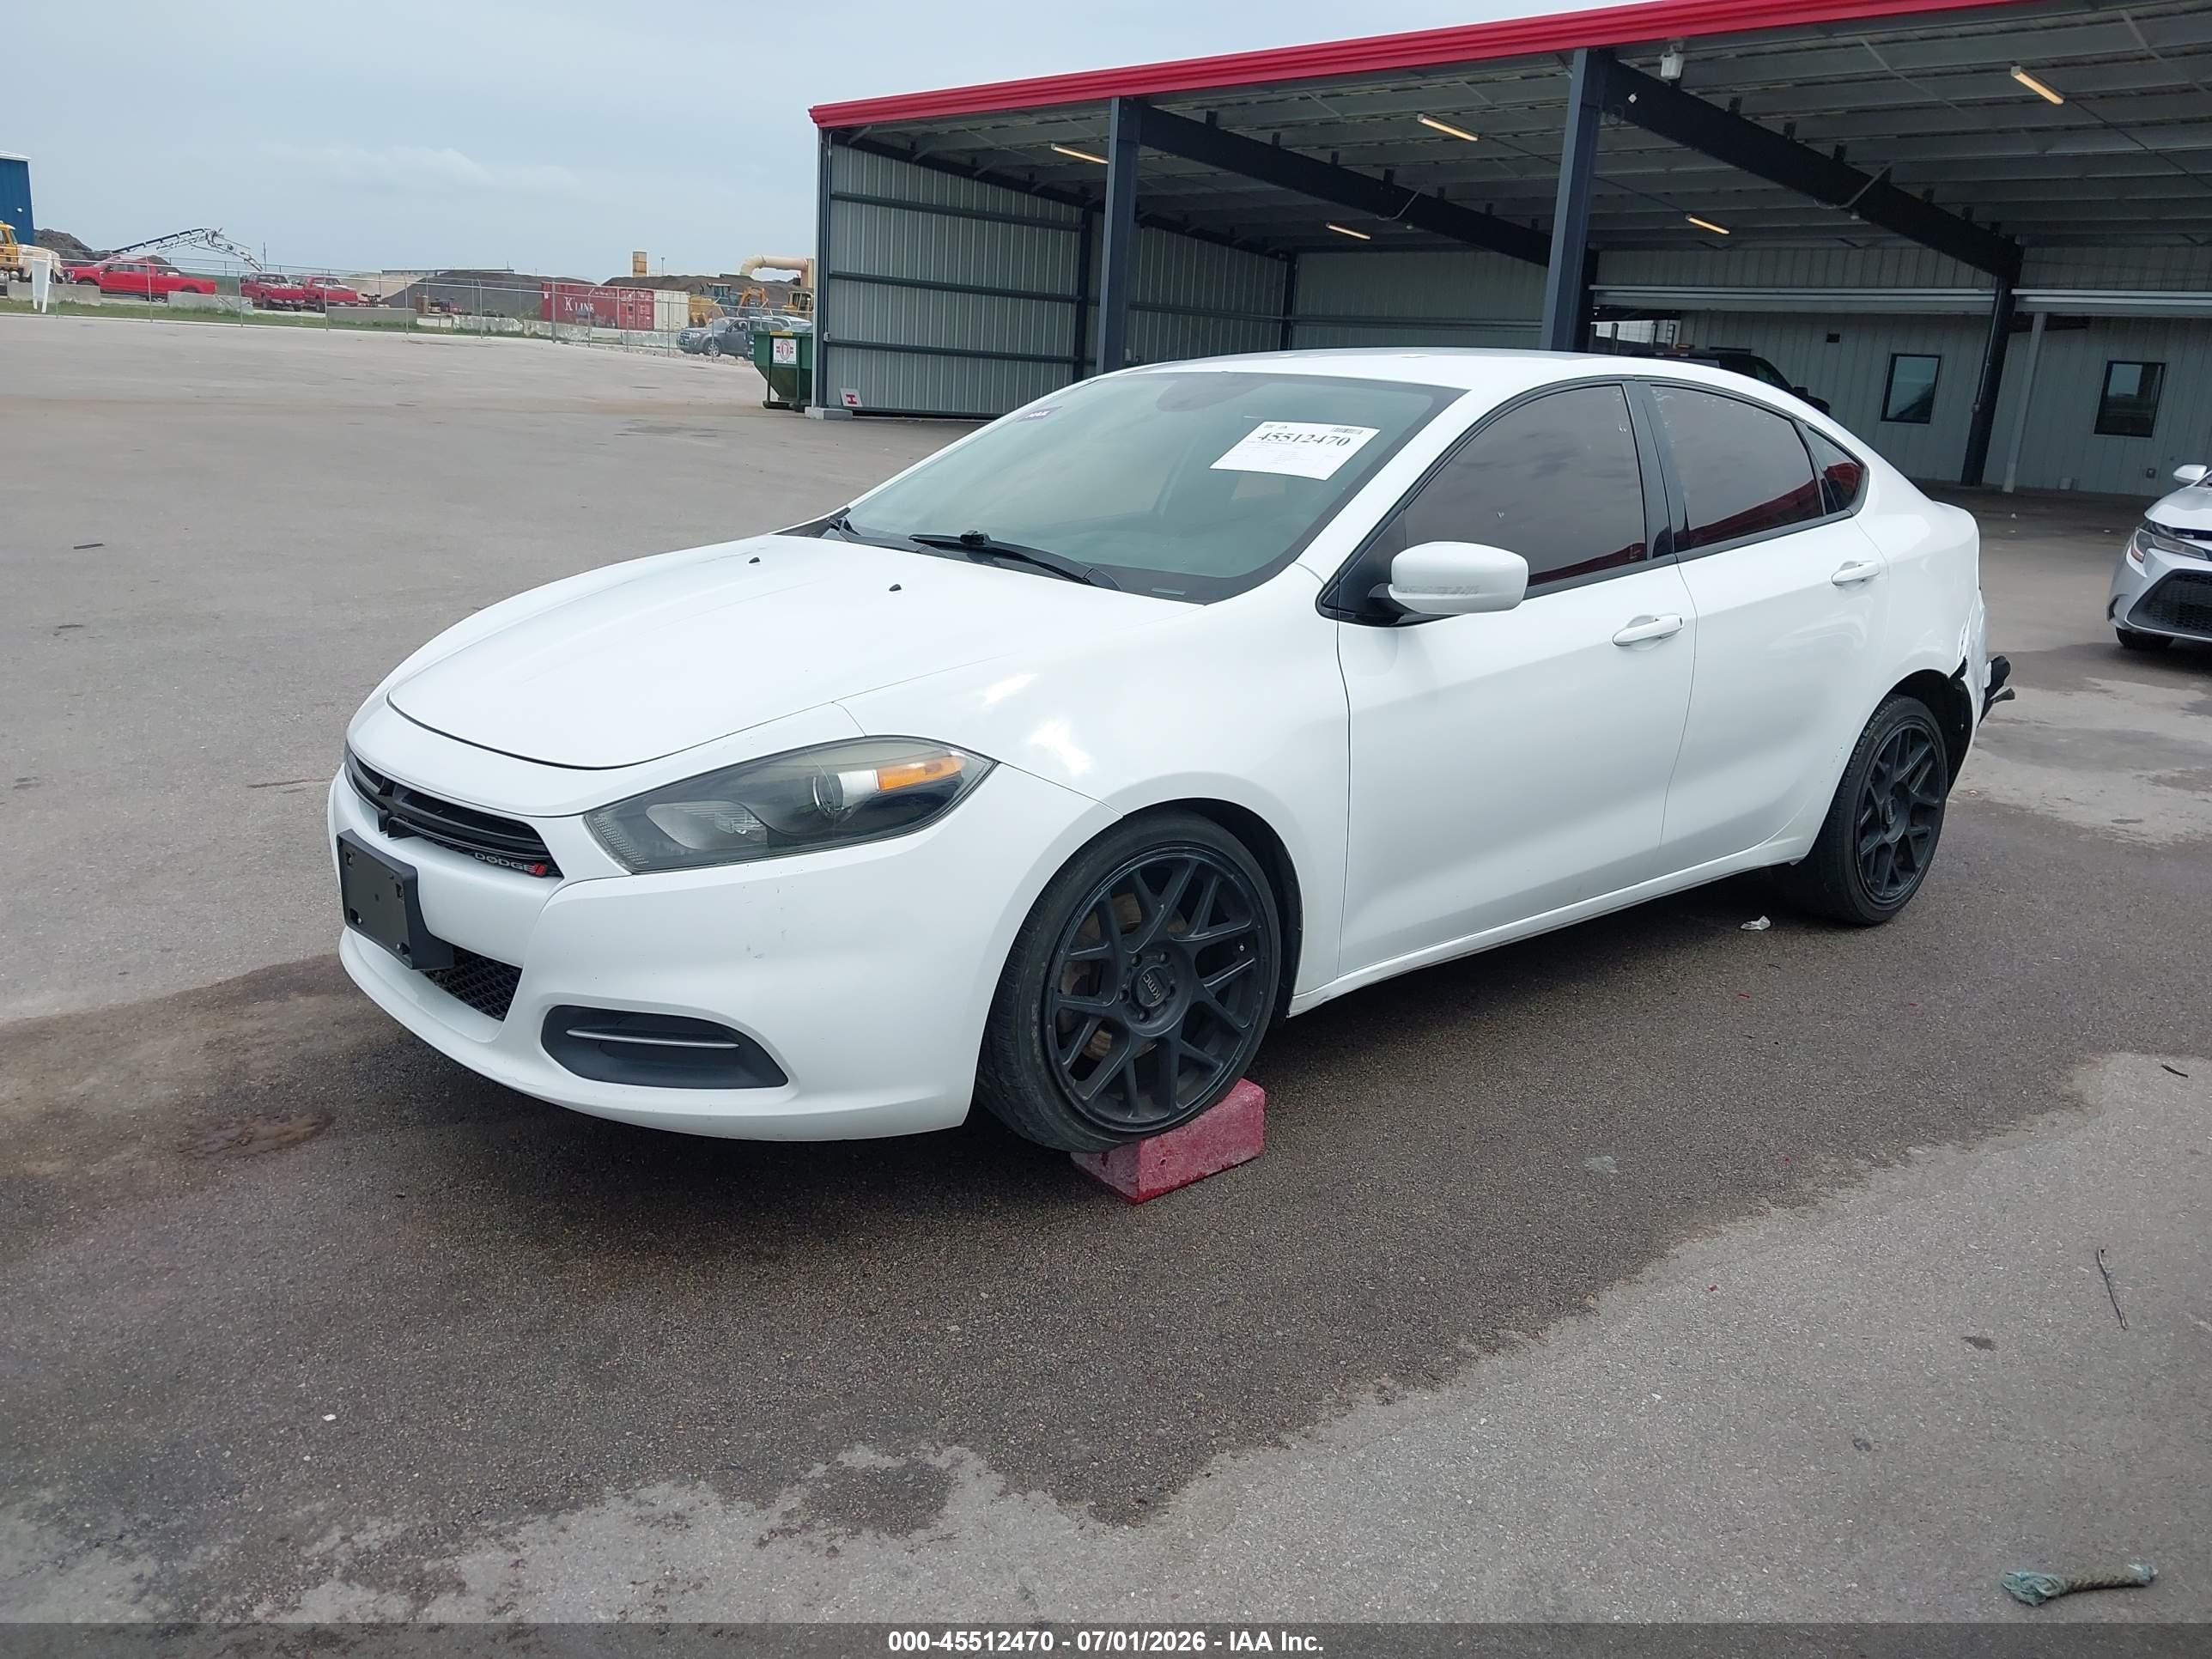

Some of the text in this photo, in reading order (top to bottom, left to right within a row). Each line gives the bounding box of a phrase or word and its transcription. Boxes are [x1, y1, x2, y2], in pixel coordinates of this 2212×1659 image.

[563, 296, 574, 312] K
[1258, 432, 1351, 447] 45512470
[475, 852, 537, 873] DODGE
